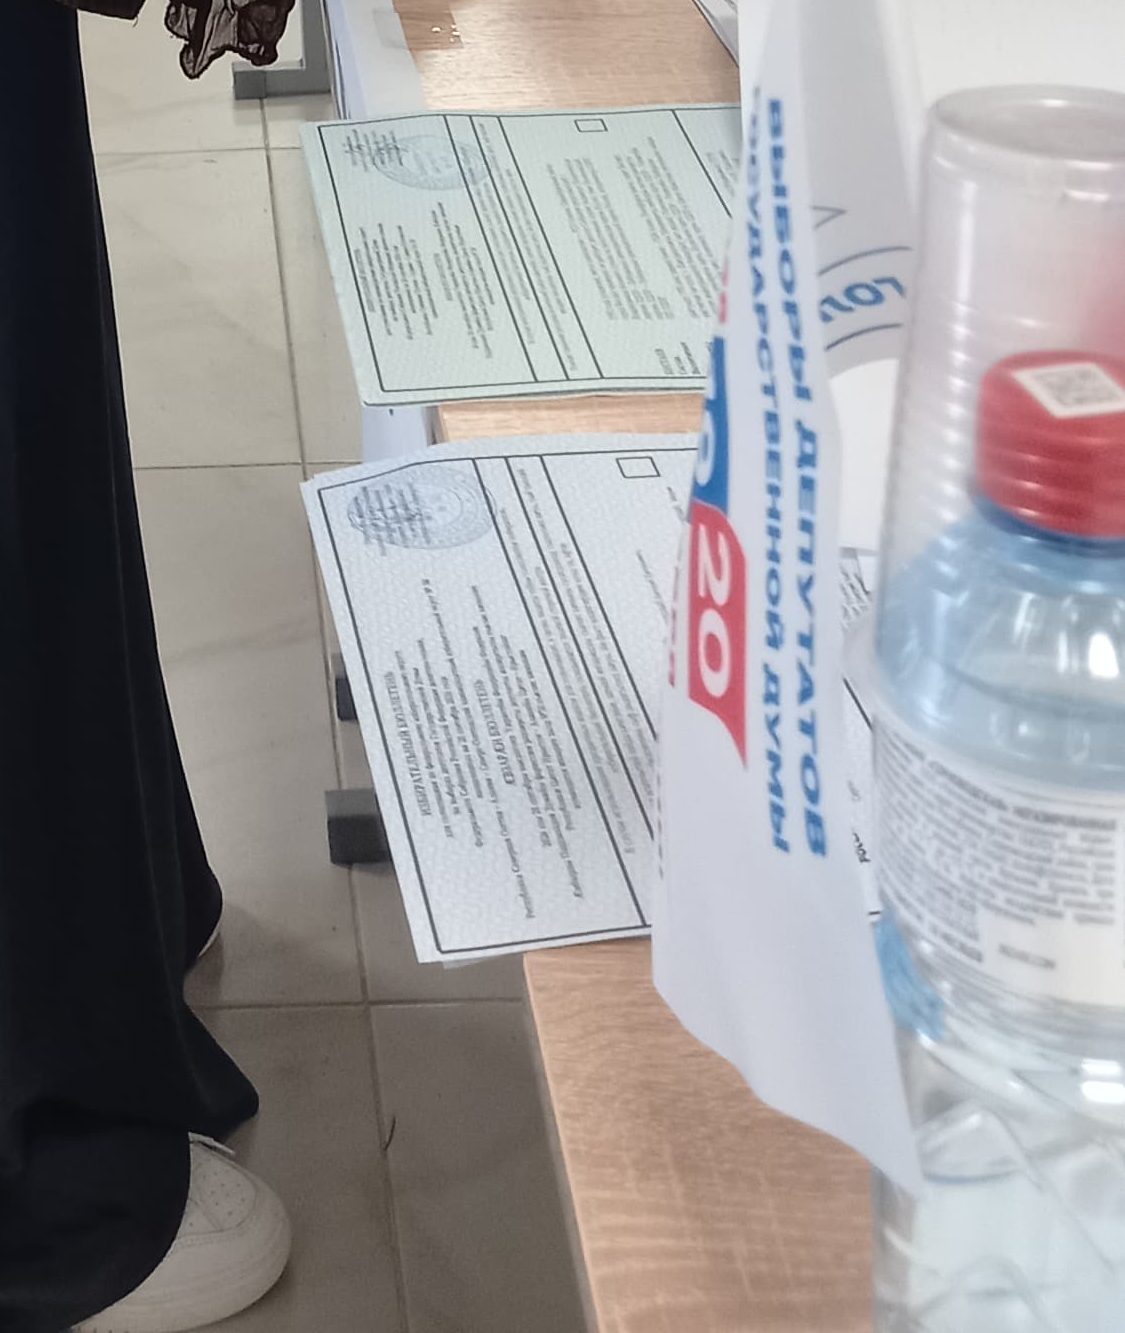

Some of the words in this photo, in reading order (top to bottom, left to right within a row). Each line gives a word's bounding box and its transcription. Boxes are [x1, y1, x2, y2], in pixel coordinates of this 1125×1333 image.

[769, 98, 811, 401] ВЫБОРЫ
[794, 419, 828, 857] ДЕПУТАТОВ
[696, 523, 732, 698] 20
[763, 662, 790, 854] ДУМЫ
